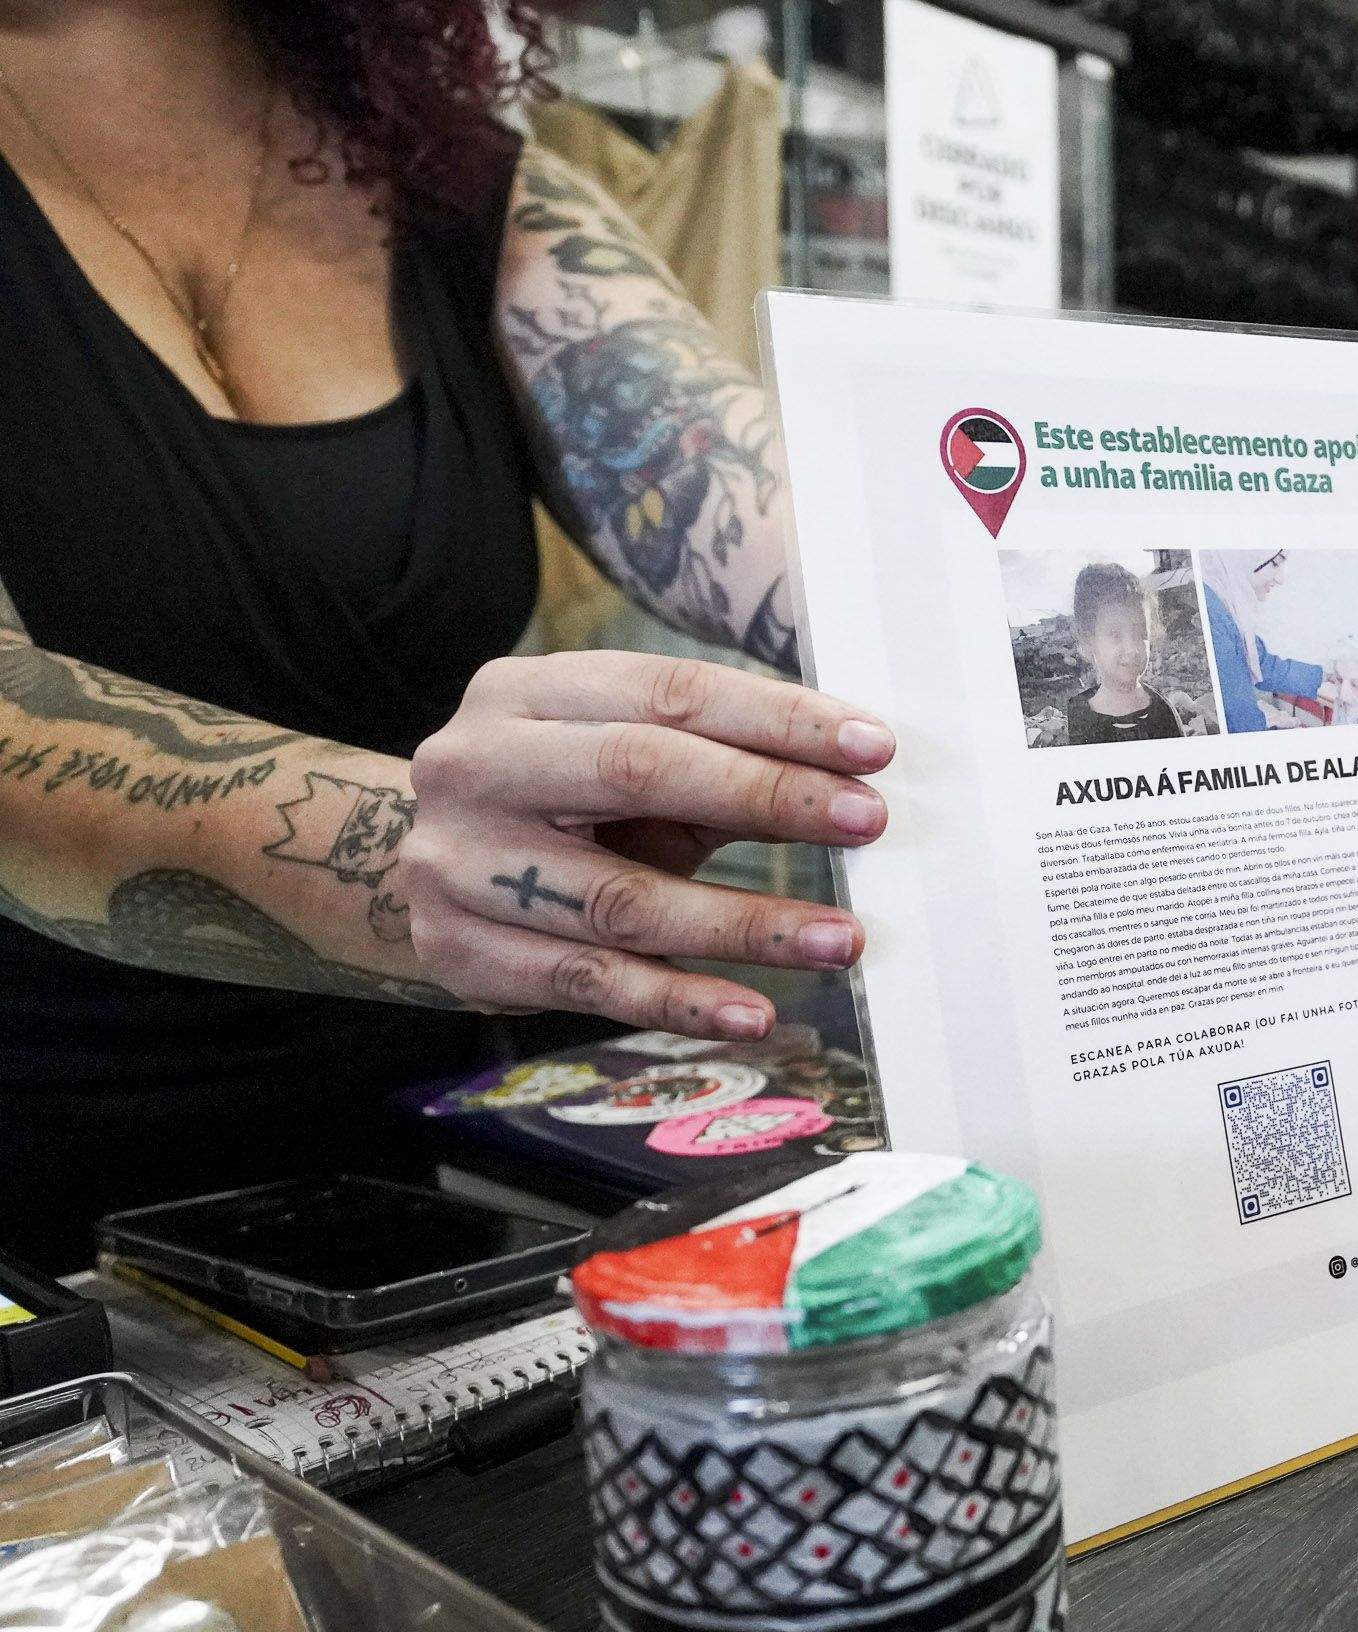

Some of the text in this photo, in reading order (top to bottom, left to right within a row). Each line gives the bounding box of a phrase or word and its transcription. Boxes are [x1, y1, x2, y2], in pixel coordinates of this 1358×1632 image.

[1034, 421, 1094, 451] Este
[1100, 426, 1308, 458] establecemento
[1040, 461, 1334, 494] a unha familia en Gaza
[1056, 774, 1155, 805] AXUDA
[1156, 767, 1176, 796] Á
[1177, 762, 1281, 794] FAMILIA
[1286, 758, 1320, 783] DE
[1035, 831, 1053, 841] Son
[1076, 827, 1089, 836] de
[1112, 822, 1135, 832] Teño
[1135, 820, 1146, 830] 26
[1037, 845, 1055, 854] dos
[1055, 842, 1080, 852] meus
[1080, 840, 1103, 850] dous
[1103, 836, 1141, 847] fermosos
[1081, 851, 1126, 863] Traballaba
[1126, 849, 1151, 858] como
[1041, 875, 1054, 883] eu
[1055, 869, 1085, 881] estaba
[1085, 863, 1138, 877] embarazada
[1138, 861, 1150, 871] de
[1151, 860, 1168, 869] sete
[1169, 856, 1196, 866] meses
[1080, 883, 1100, 895] pola
[1100, 881, 1122, 891] noite
[1122, 879, 1139, 888] con
[1139, 876, 1158, 887] algo
[1158, 872, 1188, 885] pesado
[1072, 896, 1119, 910] Decateime
[1119, 894, 1131, 903] de
[1131, 892, 1149, 902] que
[1148, 888, 1176, 899] estaba
[1049, 917, 1069, 929] pola
[1069, 913, 1093, 924] miña
[1092, 911, 1109, 921] filla
[1108, 911, 1115, 919] e
[1115, 908, 1135, 920] polo
[1135, 906, 1155, 915] meu
[1051, 933, 1068, 943] dos
[1108, 922, 1143, 934] mentres
[1142, 921, 1150, 929] o
[1150, 917, 1179, 928] sangue
[1180, 915, 1194, 923] me
[1096, 942, 1106, 950] as
[1106, 938, 1131, 949] dores
[1130, 936, 1142, 945] de
[1167, 928, 1194, 940] estaba
[1076, 958, 1098, 969] Logo
[1098, 954, 1123, 965] entrei
[1123, 952, 1136, 961] en
[1136, 949, 1158, 960] parto
[1158, 946, 1171, 955] no
[1170, 942, 1197, 953] medio
[1058, 976, 1075, 986] con
[1076, 969, 1117, 983] membros
[1118, 962, 1165, 976] amputados
[1164, 960, 1176, 969] ou
[1176, 957, 1193, 967] con
[1060, 987, 1099, 1001] andando
[1100, 985, 1111, 994] ao
[1146, 975, 1168, 986] onde
[1168, 972, 1182, 983] dei
[1182, 972, 1189, 980] a
[1189, 970, 1202, 979] luz
[1062, 1008, 1071, 1017] A
[1137, 990, 1180, 1005] Queremos
[1180, 984, 1211, 996] escapar
[1065, 1020, 1090, 1032] meus
[1090, 1016, 1111, 1026] fillos
[1111, 1011, 1139, 1023] nunha
[1139, 1007, 1158, 1018] vida
[1158, 1006, 1170, 1015] en
[1070, 1044, 1133, 1065] ESCANEA
[1136, 1036, 1172, 1052] PARA
[1175, 1020, 1251, 1044] COLABORAR
[1255, 1015, 1276, 1030] (OU
[1280, 1011, 1299, 1024] FAI
[1302, 1004, 1336, 1019] UNHA
[1072, 1038, 1245, 1082] GRAZAS POLA TÚA AXUDA!
